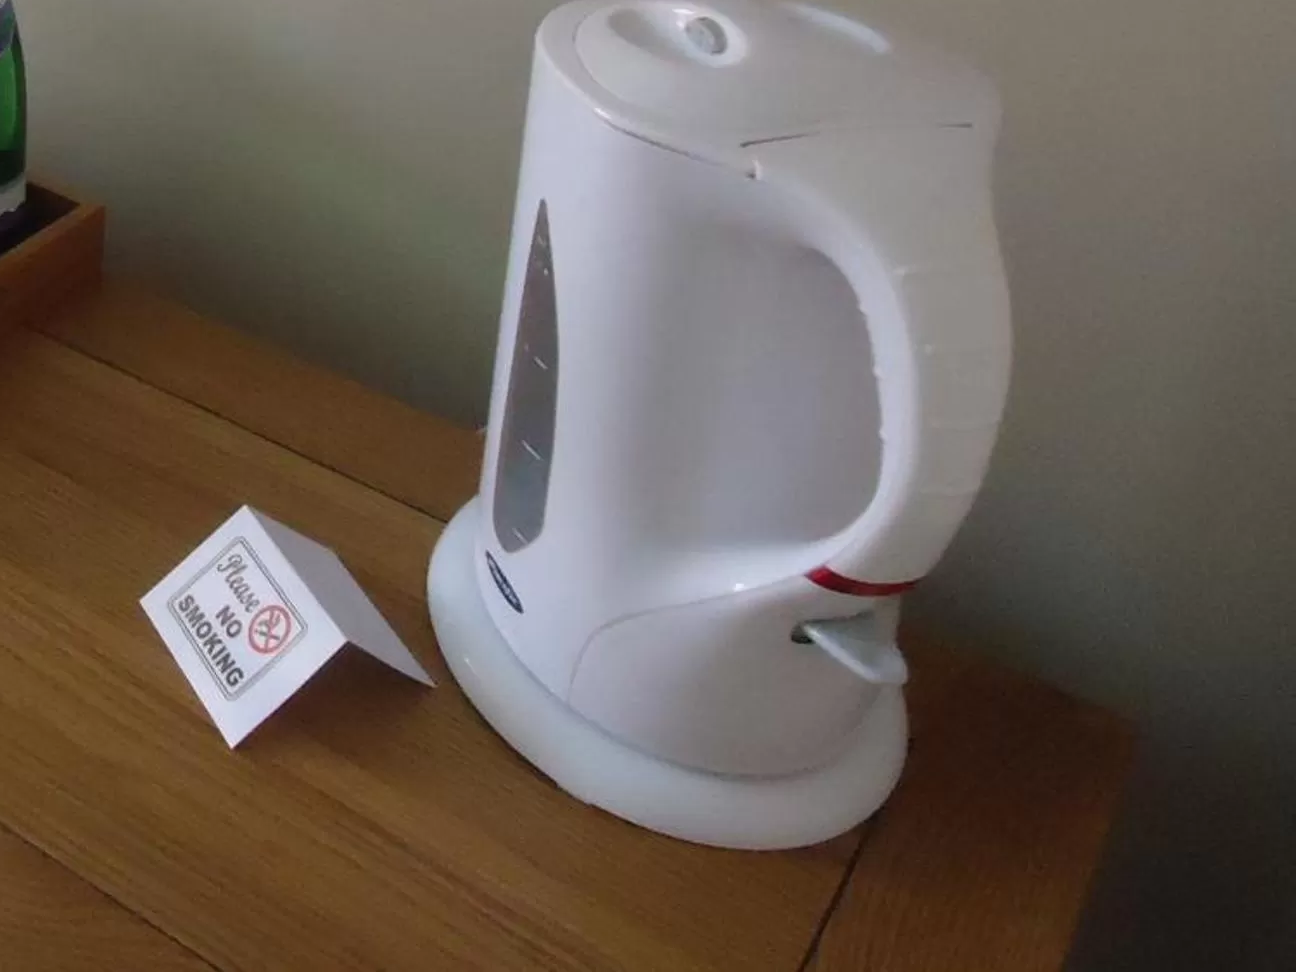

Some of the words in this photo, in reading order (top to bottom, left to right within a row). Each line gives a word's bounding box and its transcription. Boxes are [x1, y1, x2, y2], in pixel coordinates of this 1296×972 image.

[217, 553, 261, 613] Please
[179, 594, 244, 688] SMOKING
[215, 605, 243, 639] NO
